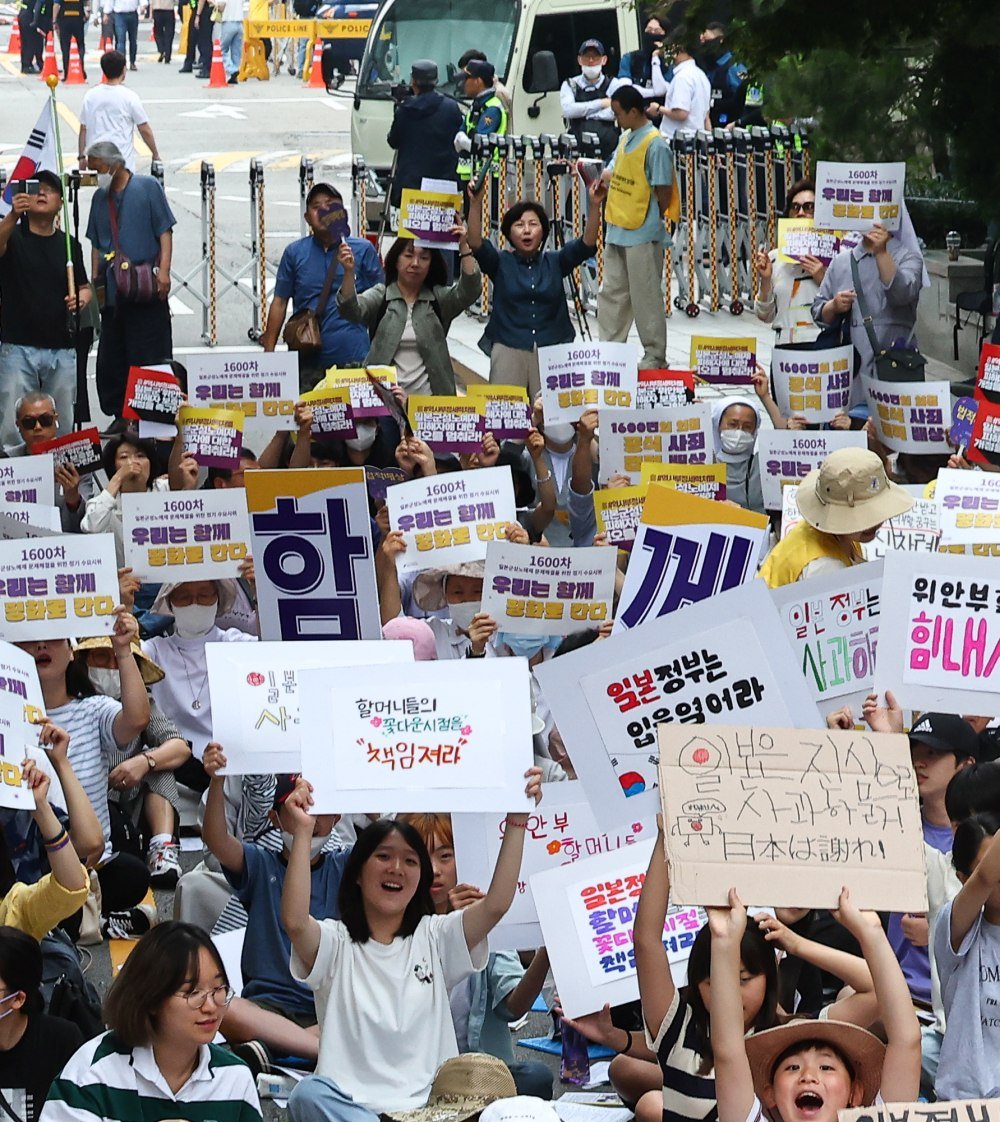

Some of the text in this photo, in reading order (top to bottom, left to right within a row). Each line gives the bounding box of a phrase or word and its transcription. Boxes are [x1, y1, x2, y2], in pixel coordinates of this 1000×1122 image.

[266, 24, 308, 34] POLICE LINE
[341, 24, 370, 34] POLIC
[848, 169, 878, 181] 1600차
[822, 187, 864, 203] 우리는
[567, 349, 601, 361] 1600차
[223, 361, 259, 373] 1600차
[780, 362, 830, 374] 1600번의
[546, 371, 621, 391] 우리는 함께
[827, 374, 850, 391] 사죄
[195, 382, 243, 401] 우리는
[249, 381, 281, 398] 함께
[604, 389, 632, 407] 간다
[868, 388, 911, 407] 1600번의
[263, 400, 295, 417] 간다
[909, 408, 943, 426] 사죄
[610, 421, 673, 434] 1600번의
[911, 424, 944, 442] 배상
[623, 431, 706, 454] 공식 사죄
[792, 439, 827, 450] 1600차
[766, 460, 812, 478] 우리는
[425, 480, 467, 497] 1600차
[163, 499, 205, 513] 1600차
[942, 494, 1000, 510] 우리는
[397, 502, 496, 532] 우리는 함께
[132, 522, 231, 546] 우리는 함께
[414, 527, 471, 552] 평화로
[21, 546, 67, 561] 1600차
[148, 541, 248, 567] 평화로 간다
[529, 556, 572, 570] 1600차
[55, 573, 97, 595] 함께
[492, 576, 595, 600] 우리는 함께
[911, 577, 989, 613] 위안부
[4, 596, 115, 622] 평화로 간다
[505, 598, 608, 621] 평화로 간다
[789, 588, 880, 640] 일본 정부는
[606, 649, 729, 714] 일본정부는
[355, 697, 438, 719] 할머니들의
[722, 832, 887, 861] 日本は謝れ!
